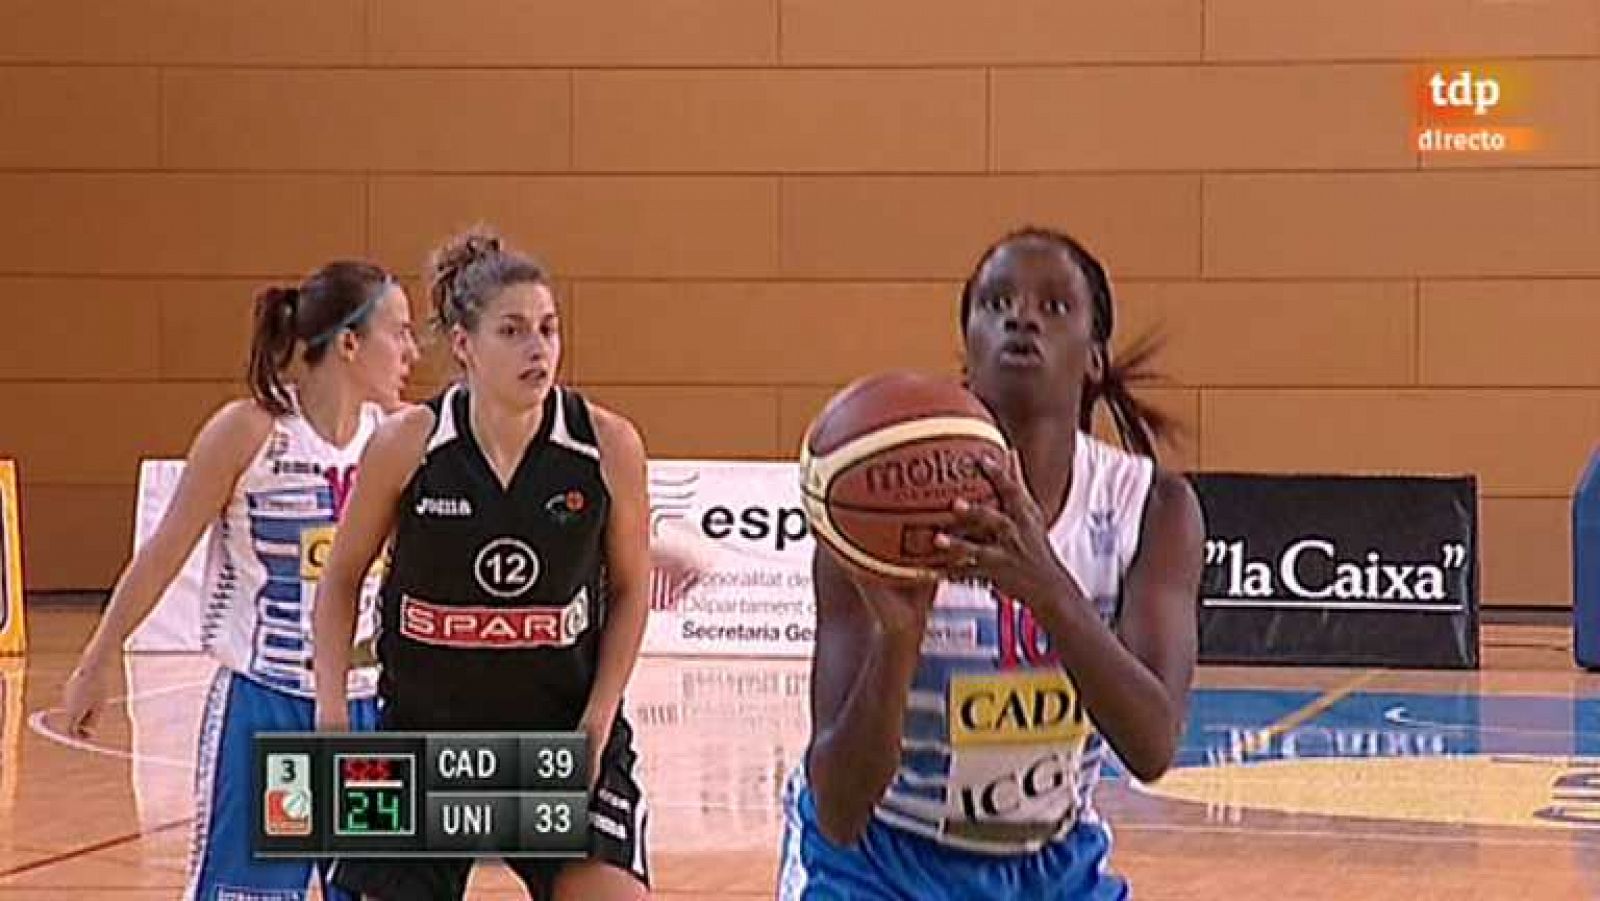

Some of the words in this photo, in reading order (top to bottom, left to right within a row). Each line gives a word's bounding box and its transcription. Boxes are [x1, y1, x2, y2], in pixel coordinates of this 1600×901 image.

[702, 506, 808, 550] esp
[486, 553, 526, 584] 12
[407, 606, 558, 640] SPAR
[682, 620, 780, 642] Secretaria
